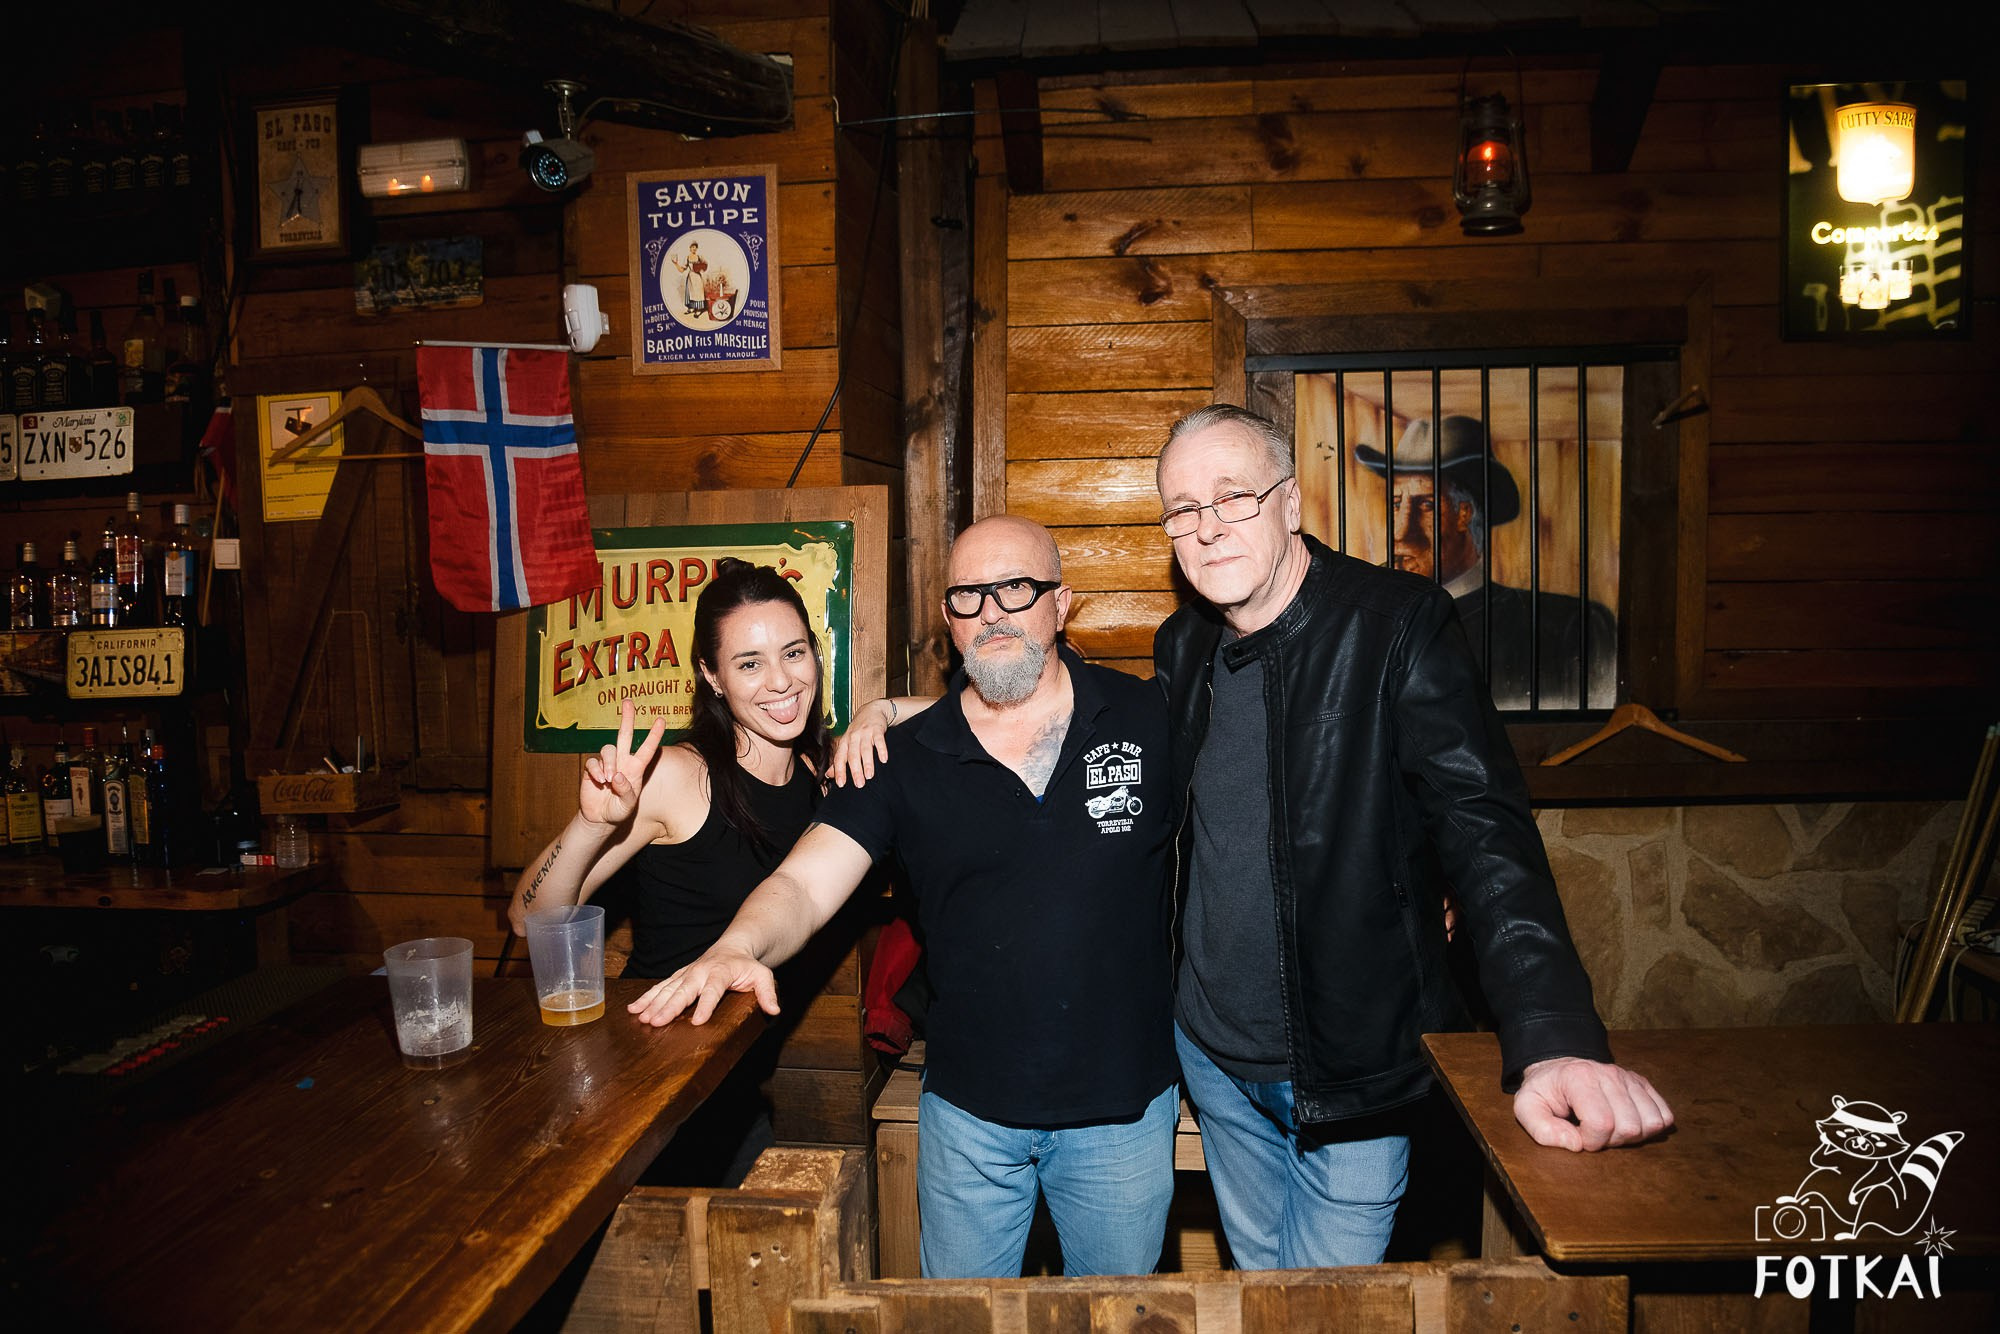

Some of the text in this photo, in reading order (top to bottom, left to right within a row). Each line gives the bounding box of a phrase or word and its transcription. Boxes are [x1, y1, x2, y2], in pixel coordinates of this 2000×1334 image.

[265, 118, 283, 139] EL
[1841, 110, 1914, 130] CUTTY SARK
[655, 181, 751, 208] SAVON
[648, 208, 759, 229] TULIPE
[644, 303, 664, 314] VENTE
[743, 309, 768, 318] PROVISION
[750, 299, 766, 308] POUR
[656, 323, 664, 332] 5
[647, 334, 693, 354] BARON
[714, 332, 767, 350] MARSEILLE
[699, 352, 721, 360] VRAIE
[53, 414, 97, 430] Maryland
[24, 428, 126, 464] ZXN 526
[569, 557, 804, 630] MURP'
[97, 639, 156, 650] CALIFORNIA
[75, 654, 175, 687] 3AIS841
[553, 629, 681, 697] EXTRA
[597, 679, 695, 705] ON DRAUGHT &
[616, 705, 695, 715] LY'S WELL BREW
[1083, 741, 1143, 763] CAFE BAR
[1090, 763, 1138, 785] EL PASO
[1100, 826, 1121, 834] APOLO
